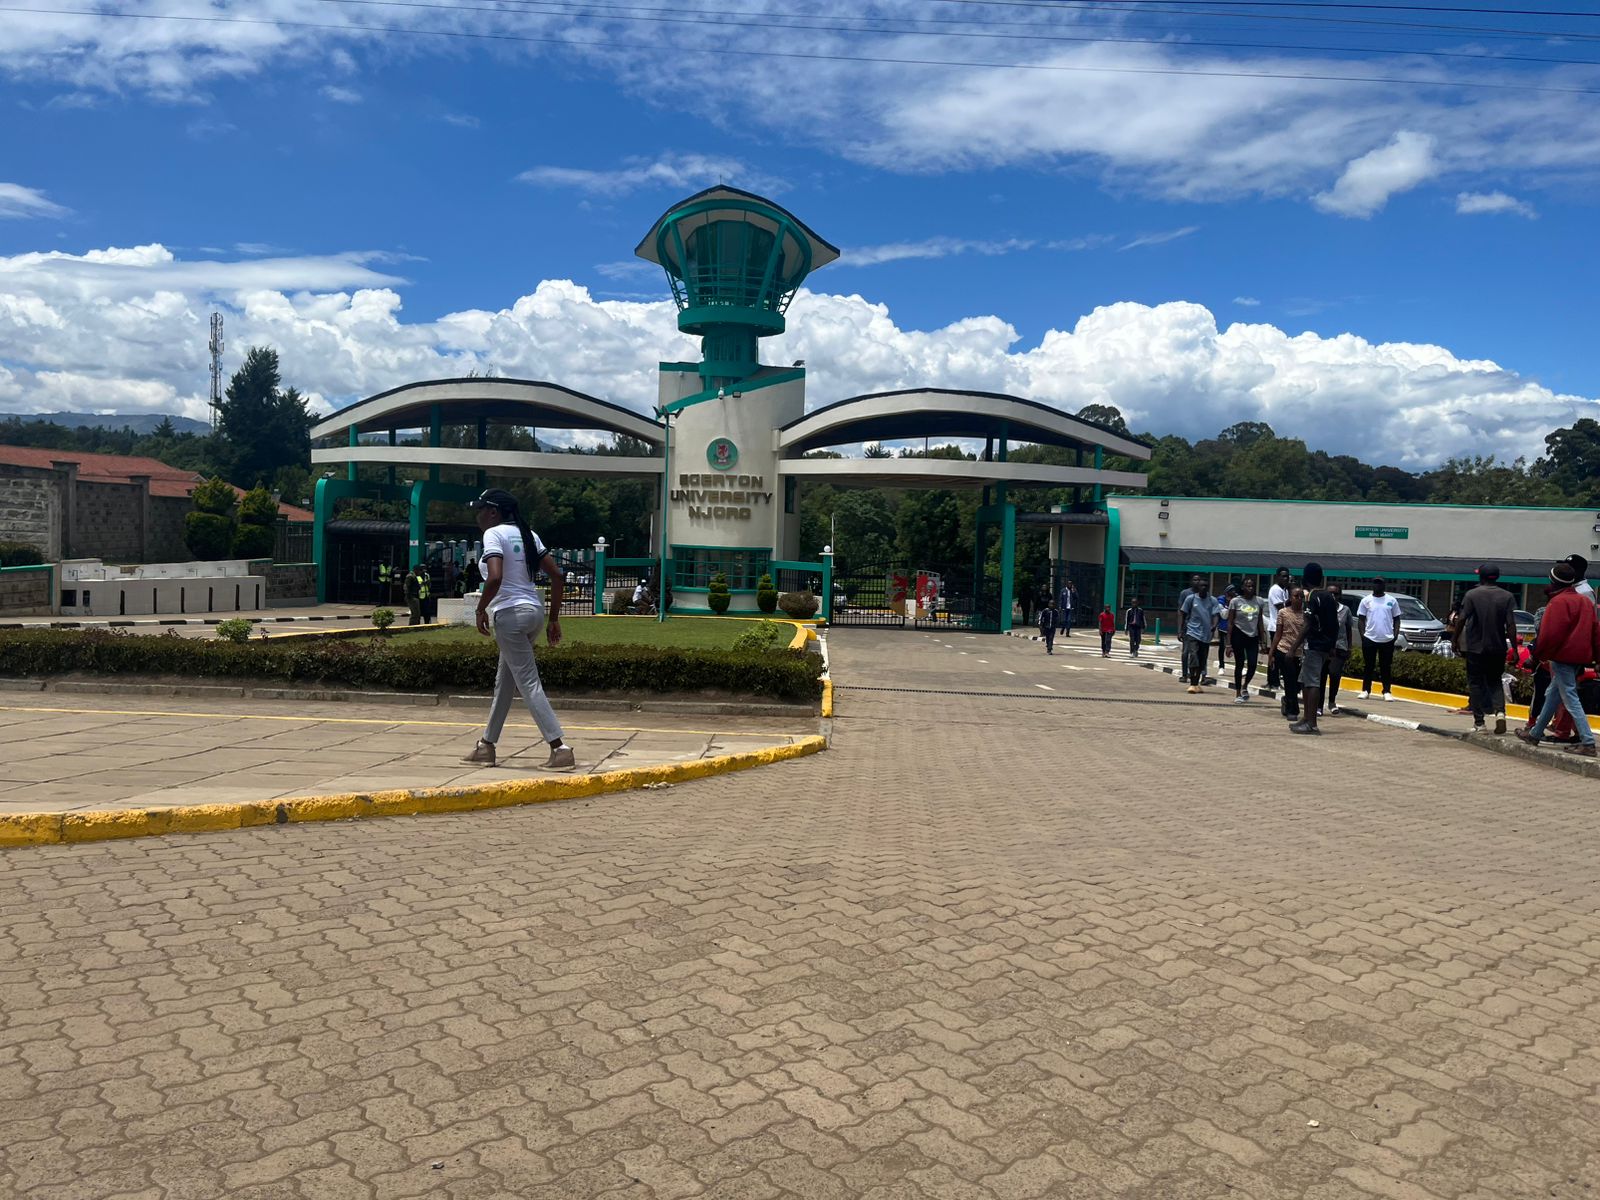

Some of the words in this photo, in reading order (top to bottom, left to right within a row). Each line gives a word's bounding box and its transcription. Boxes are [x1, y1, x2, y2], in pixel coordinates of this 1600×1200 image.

[679, 474, 763, 488] EGERTON
[670, 489, 773, 504] UNIVERSITY
[688, 505, 752, 520] NJORO
